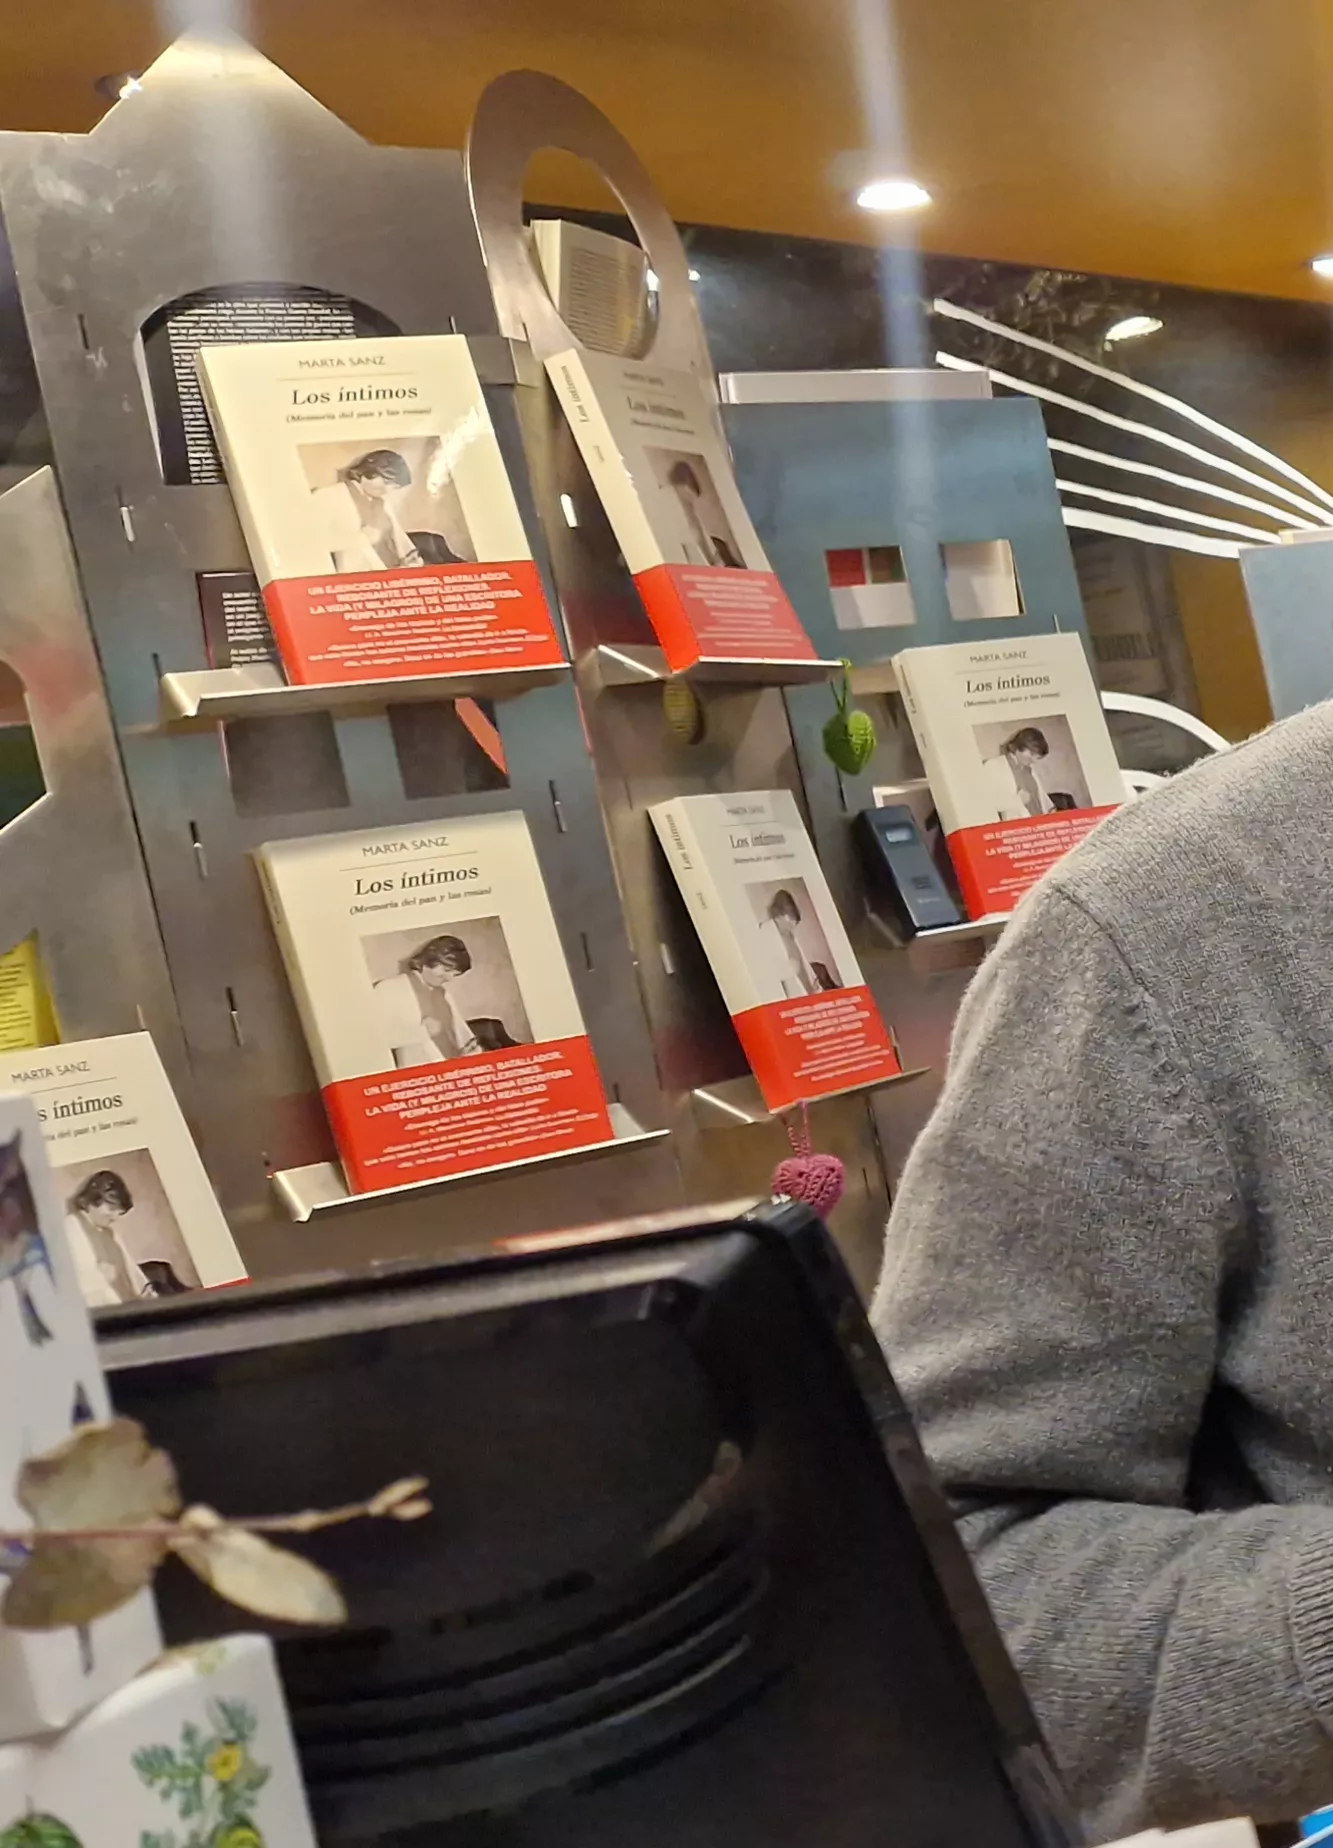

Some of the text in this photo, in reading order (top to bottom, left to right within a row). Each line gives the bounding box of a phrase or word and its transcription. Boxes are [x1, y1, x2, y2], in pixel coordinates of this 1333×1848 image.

[298, 356, 386, 369] MARTA SANZ
[292, 385, 418, 405] Los íntimos
[966, 674, 1051, 694] Los íntimos
[362, 836, 450, 857] MARTA SANZ
[355, 866, 480, 896] Los íntimos
[10, 1060, 91, 1083] MARTA SANZ
[53, 1094, 124, 1120] íntimos
